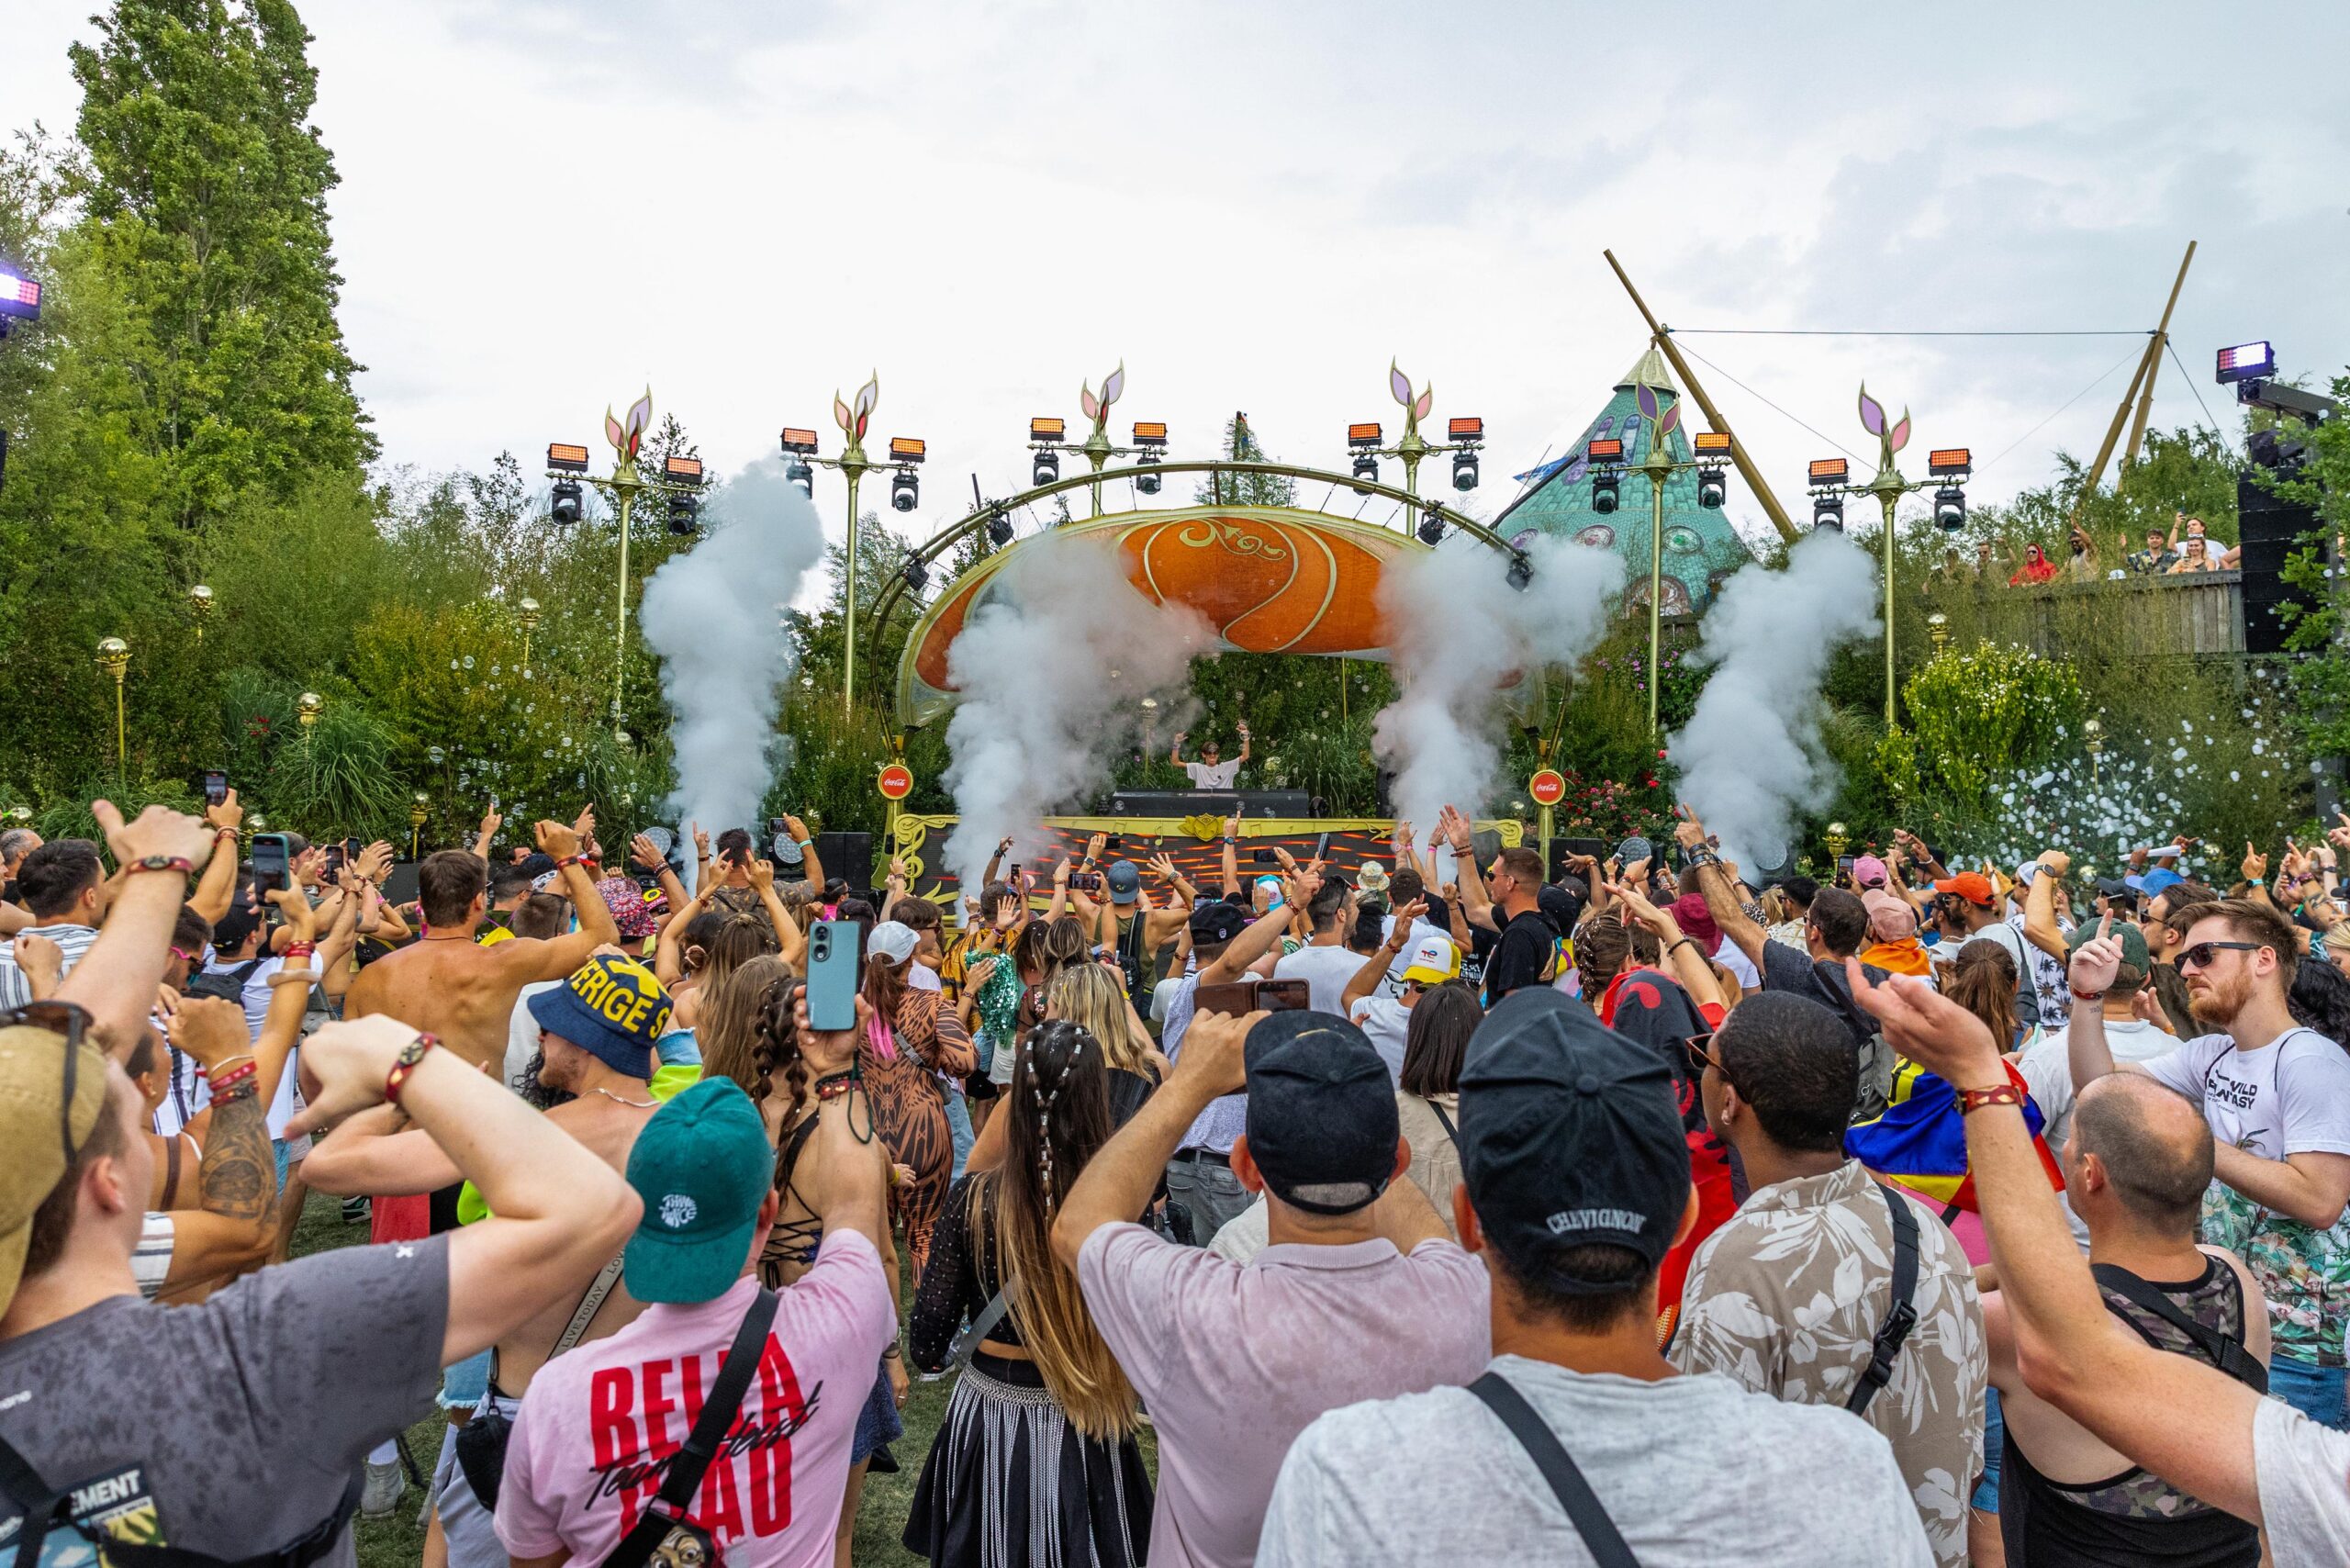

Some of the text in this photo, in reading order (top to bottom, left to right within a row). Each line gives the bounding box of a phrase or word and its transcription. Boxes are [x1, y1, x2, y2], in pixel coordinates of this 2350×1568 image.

[1546, 1208, 1648, 1235] CHEVIGNON
[561, 1248, 625, 1349] LIVE TODAY LOV
